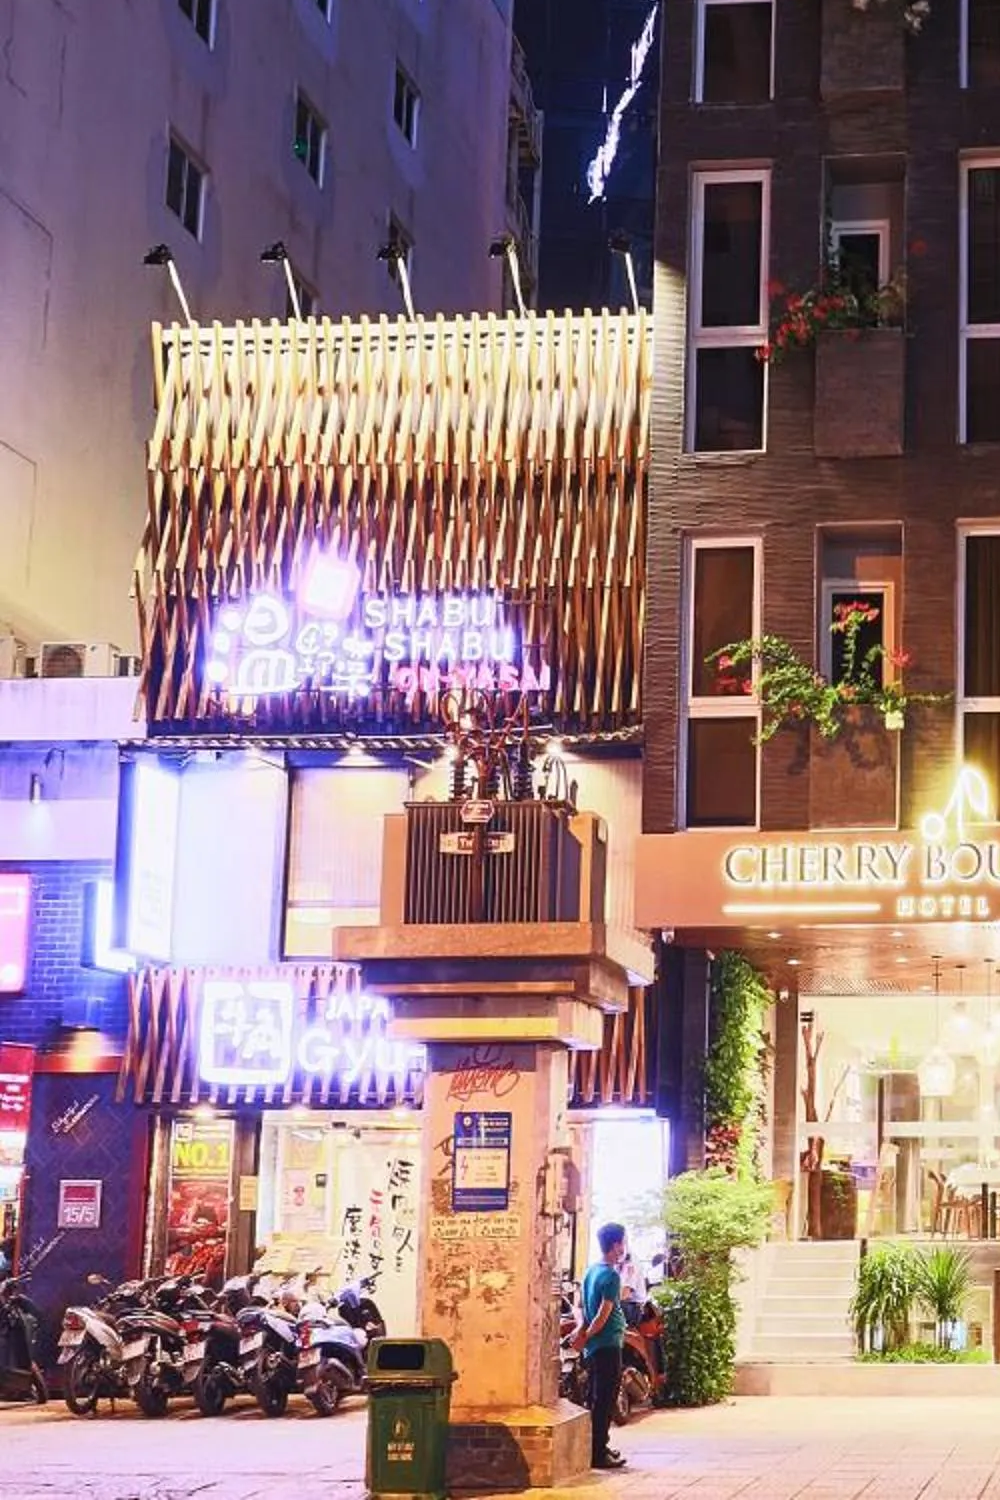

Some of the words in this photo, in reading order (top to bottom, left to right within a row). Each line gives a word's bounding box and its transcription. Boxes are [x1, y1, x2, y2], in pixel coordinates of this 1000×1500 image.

[364, 599, 496, 628] SHABU
[383, 631, 514, 661] SHABU
[723, 842, 910, 885] CHERRY
[896, 896, 991, 917] HOTEL
[174, 1140, 229, 1168] NO.1
